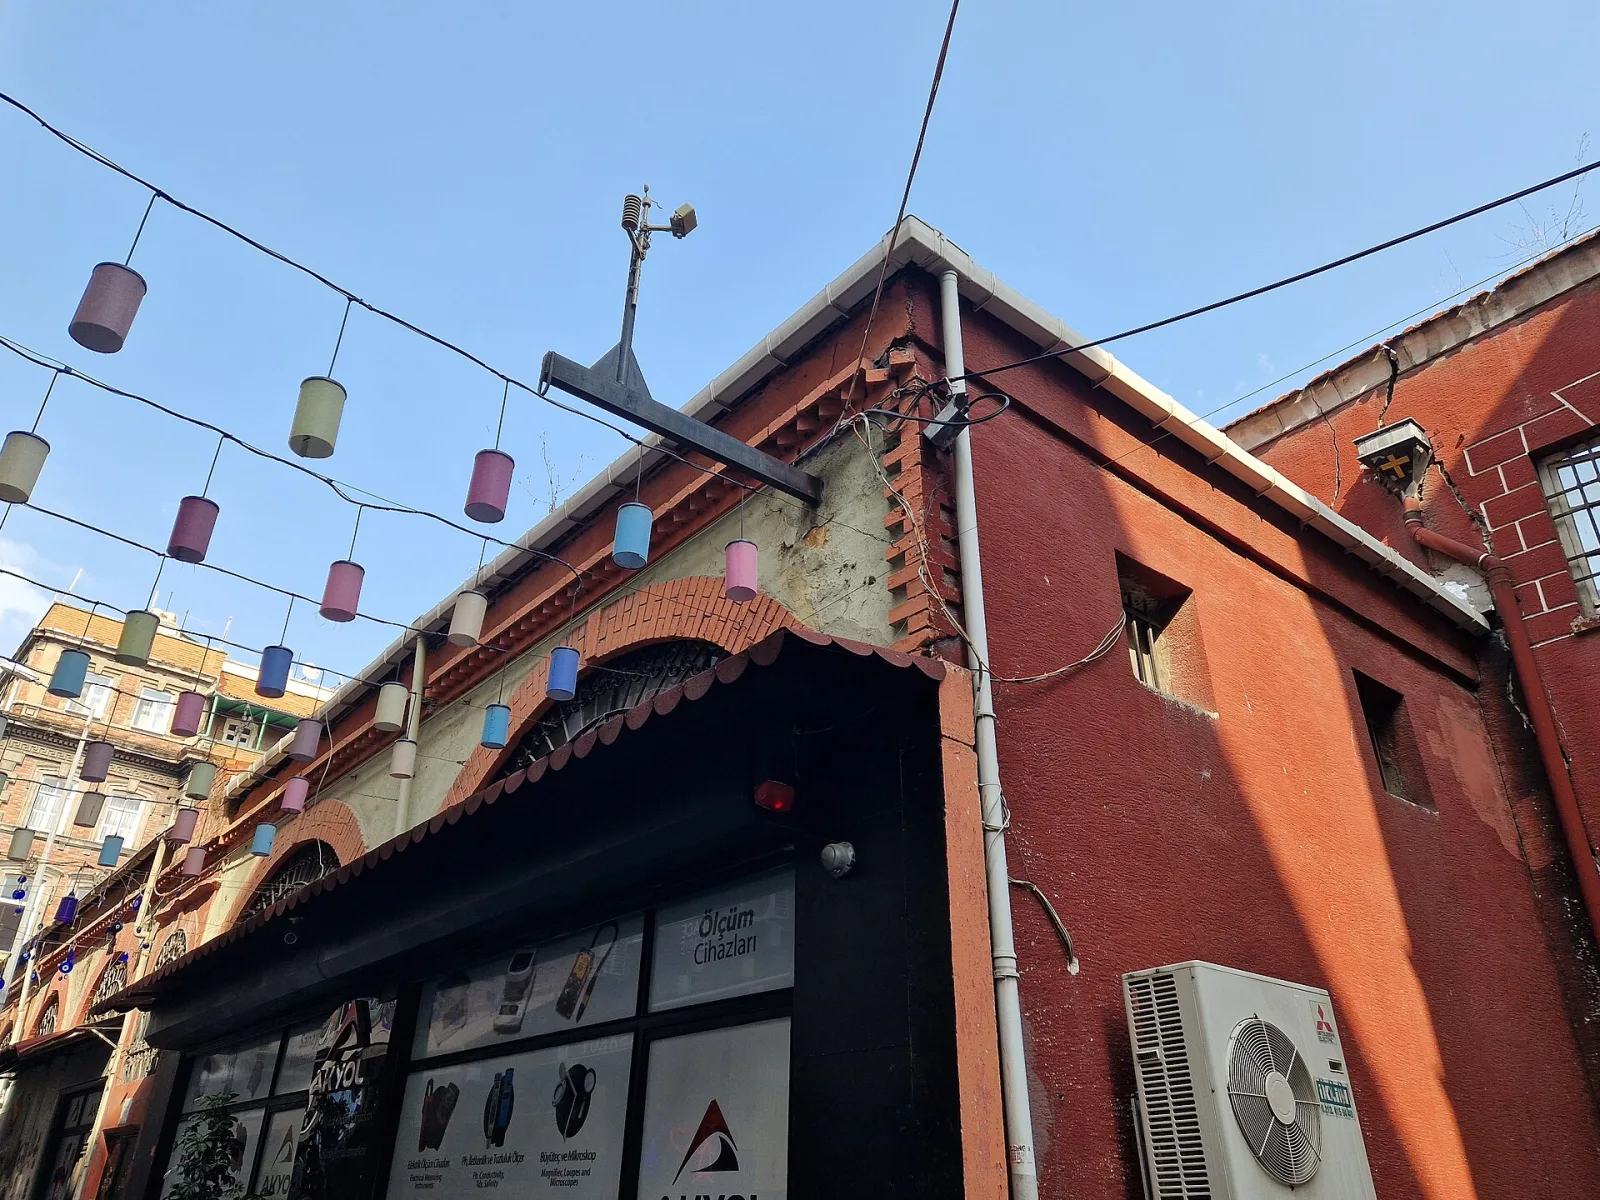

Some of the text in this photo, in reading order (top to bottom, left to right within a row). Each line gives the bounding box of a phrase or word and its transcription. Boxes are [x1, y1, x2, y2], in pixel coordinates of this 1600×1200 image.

[699, 907, 754, 941] Ölçüm
[694, 933, 757, 965] Cihazları
[568, 1149, 597, 1163] Mikroskop
[581, 1167, 591, 1176] and
[260, 1174, 291, 1195] AKYO
[550, 1178, 579, 1188] Microscopes
